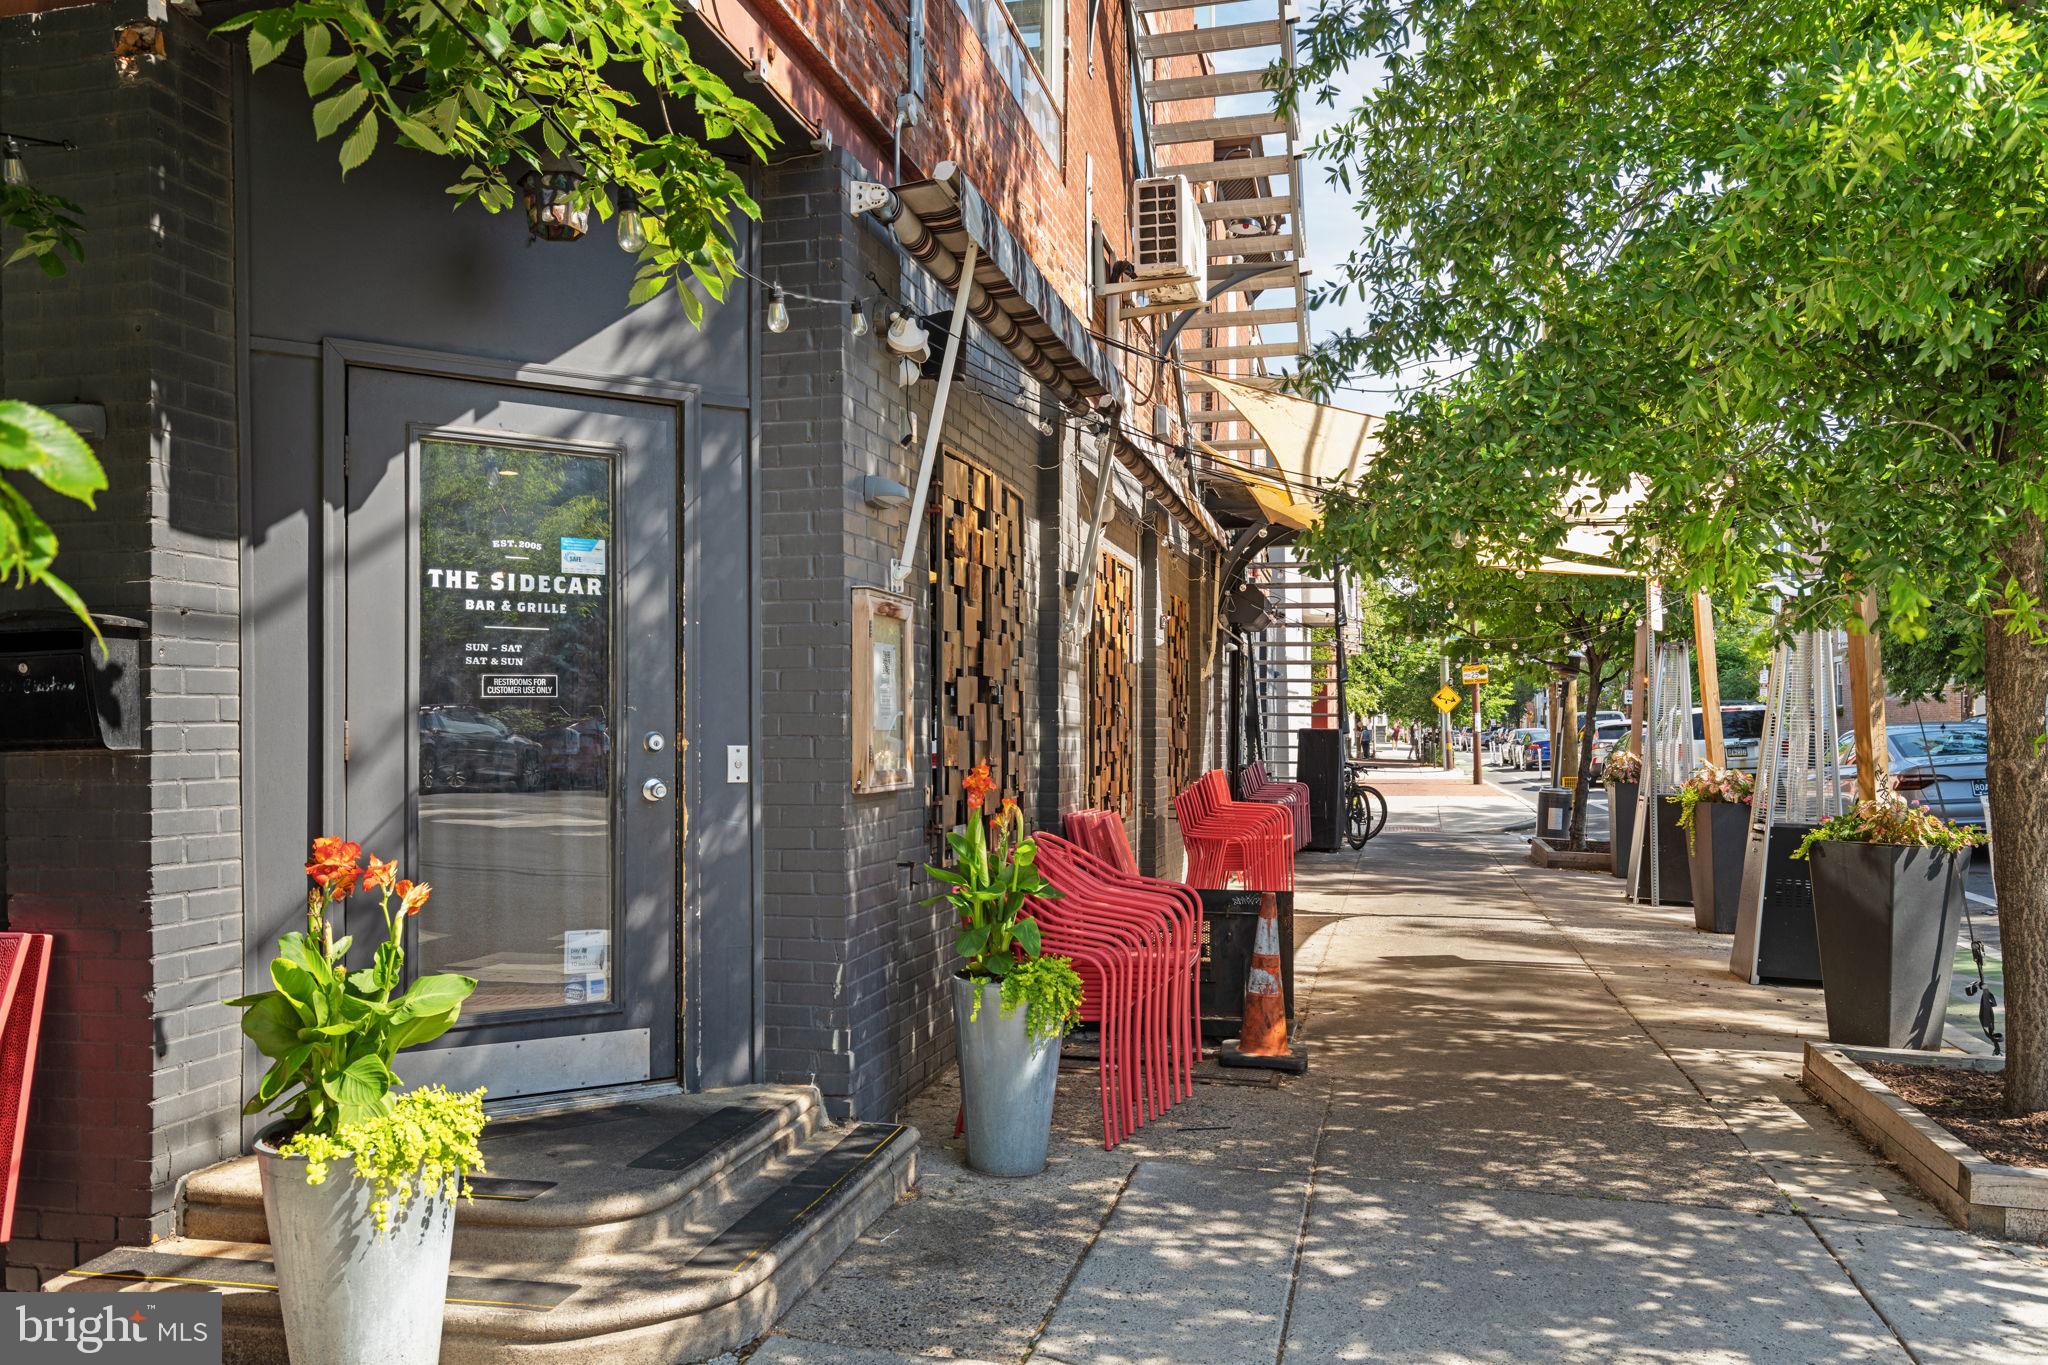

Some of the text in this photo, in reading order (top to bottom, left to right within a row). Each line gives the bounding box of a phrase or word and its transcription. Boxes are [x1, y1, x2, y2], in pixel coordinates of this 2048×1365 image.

[427, 568, 602, 596] THE SIDECAR
[465, 599, 567, 614] BAR & GRILLE
[465, 643, 489, 651] SUN
[500, 644, 522, 653] SAT
[465, 656, 523, 666] SAT & SUN
[493, 678, 547, 686] RESTROOMS FOR
[487, 686, 553, 694] CUSTOMER USE ONLY
